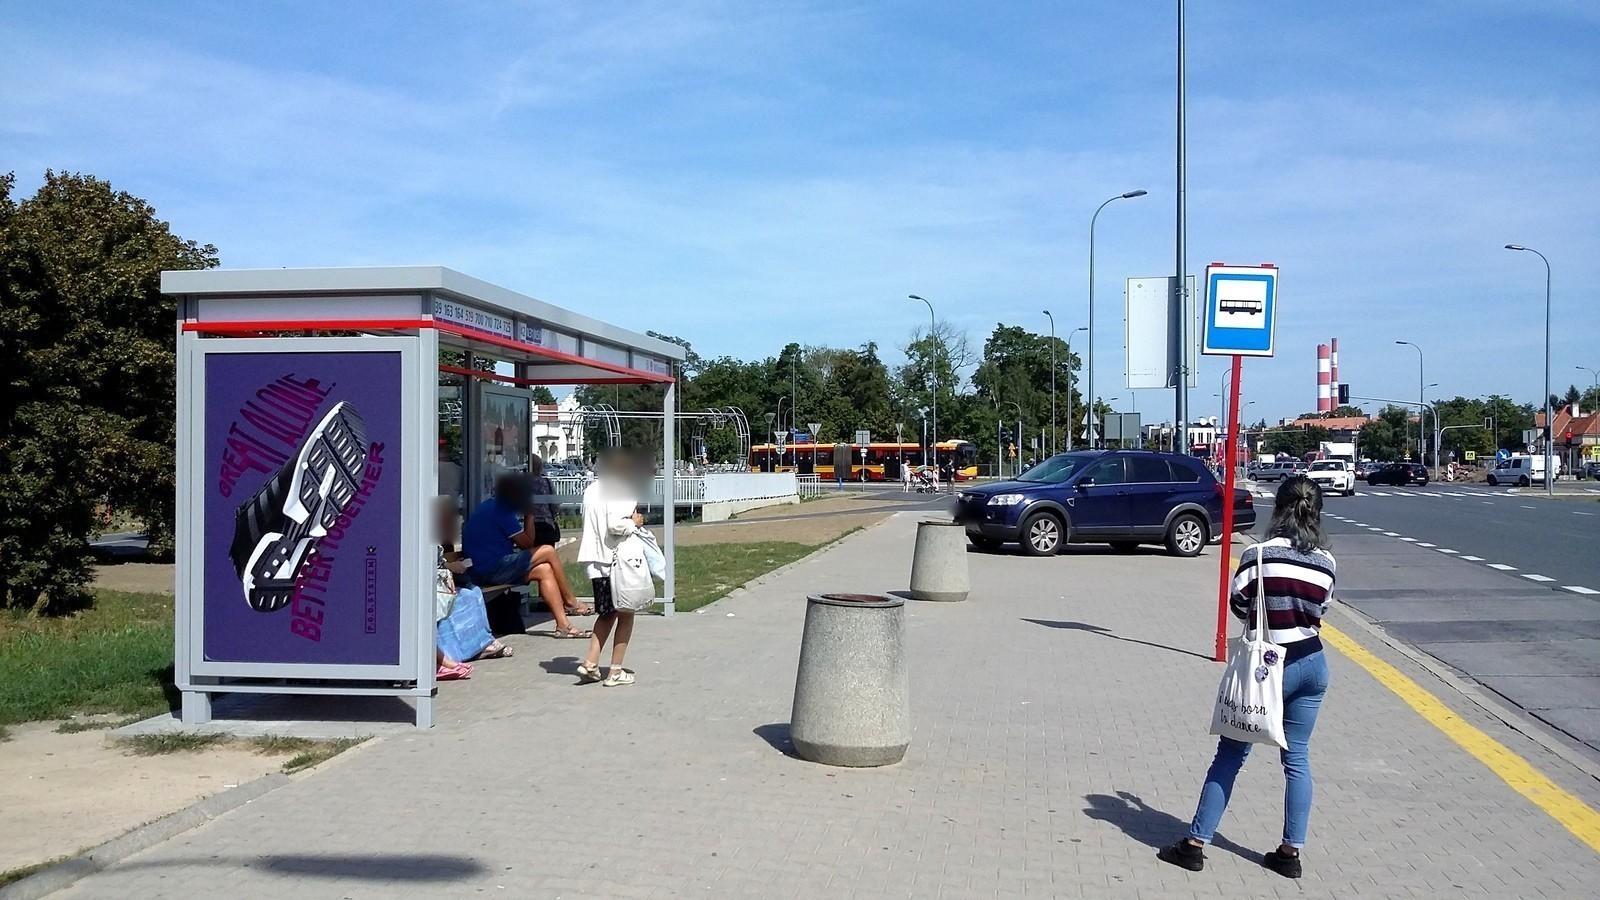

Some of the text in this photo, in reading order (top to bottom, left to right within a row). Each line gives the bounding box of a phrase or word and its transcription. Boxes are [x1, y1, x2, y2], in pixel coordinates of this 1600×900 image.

[444, 304, 454, 318] 163
[455, 306, 464, 319] 164
[465, 310, 474, 322] 519
[475, 313, 484, 326] 700
[485, 315, 493, 329] 710
[494, 318, 502, 330] 724
[219, 421, 290, 498] GREAT
[291, 441, 385, 642] BETTER TOGETHER
[1241, 698, 1268, 715] born
[1230, 714, 1261, 733] dance
